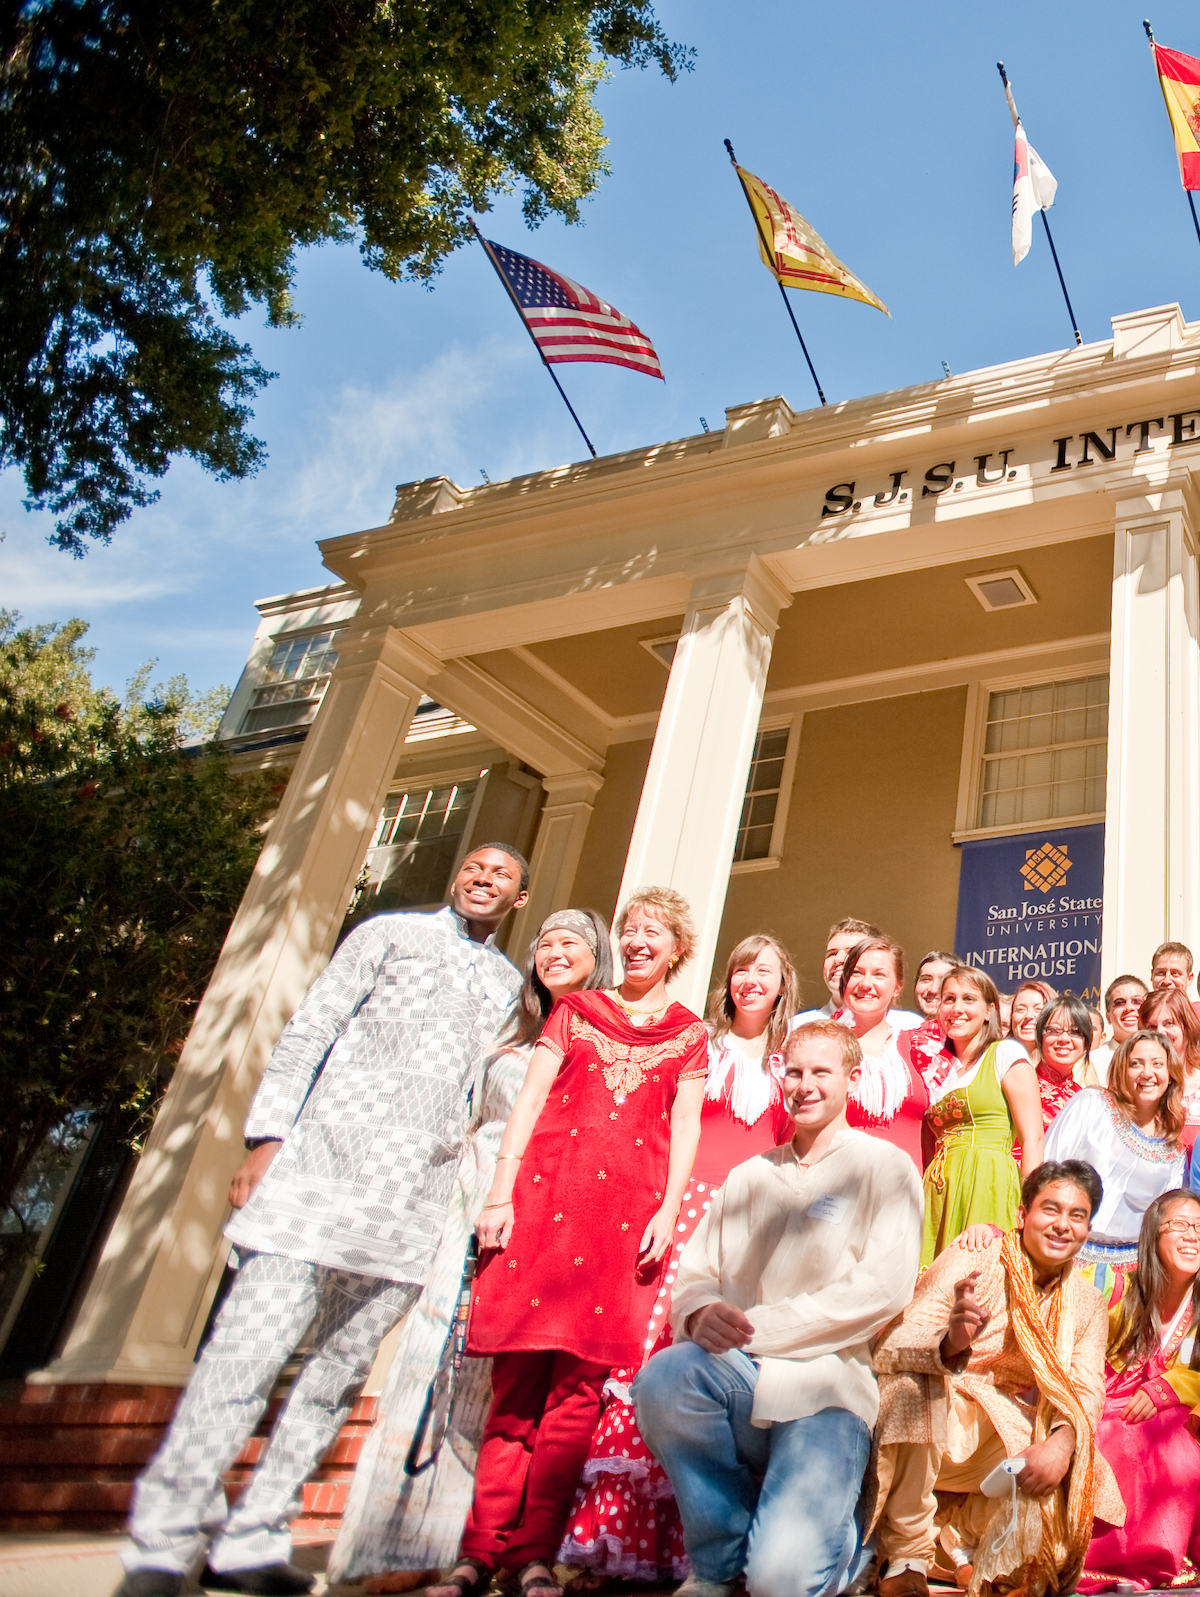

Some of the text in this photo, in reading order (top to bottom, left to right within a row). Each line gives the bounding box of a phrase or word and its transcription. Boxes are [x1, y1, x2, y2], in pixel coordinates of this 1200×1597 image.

[987, 896, 1103, 921] San José State
[987, 915, 1102, 937] UNIVERSITY
[966, 938, 1103, 967] INTERNATION
[1008, 958, 1076, 981] HOUSE
